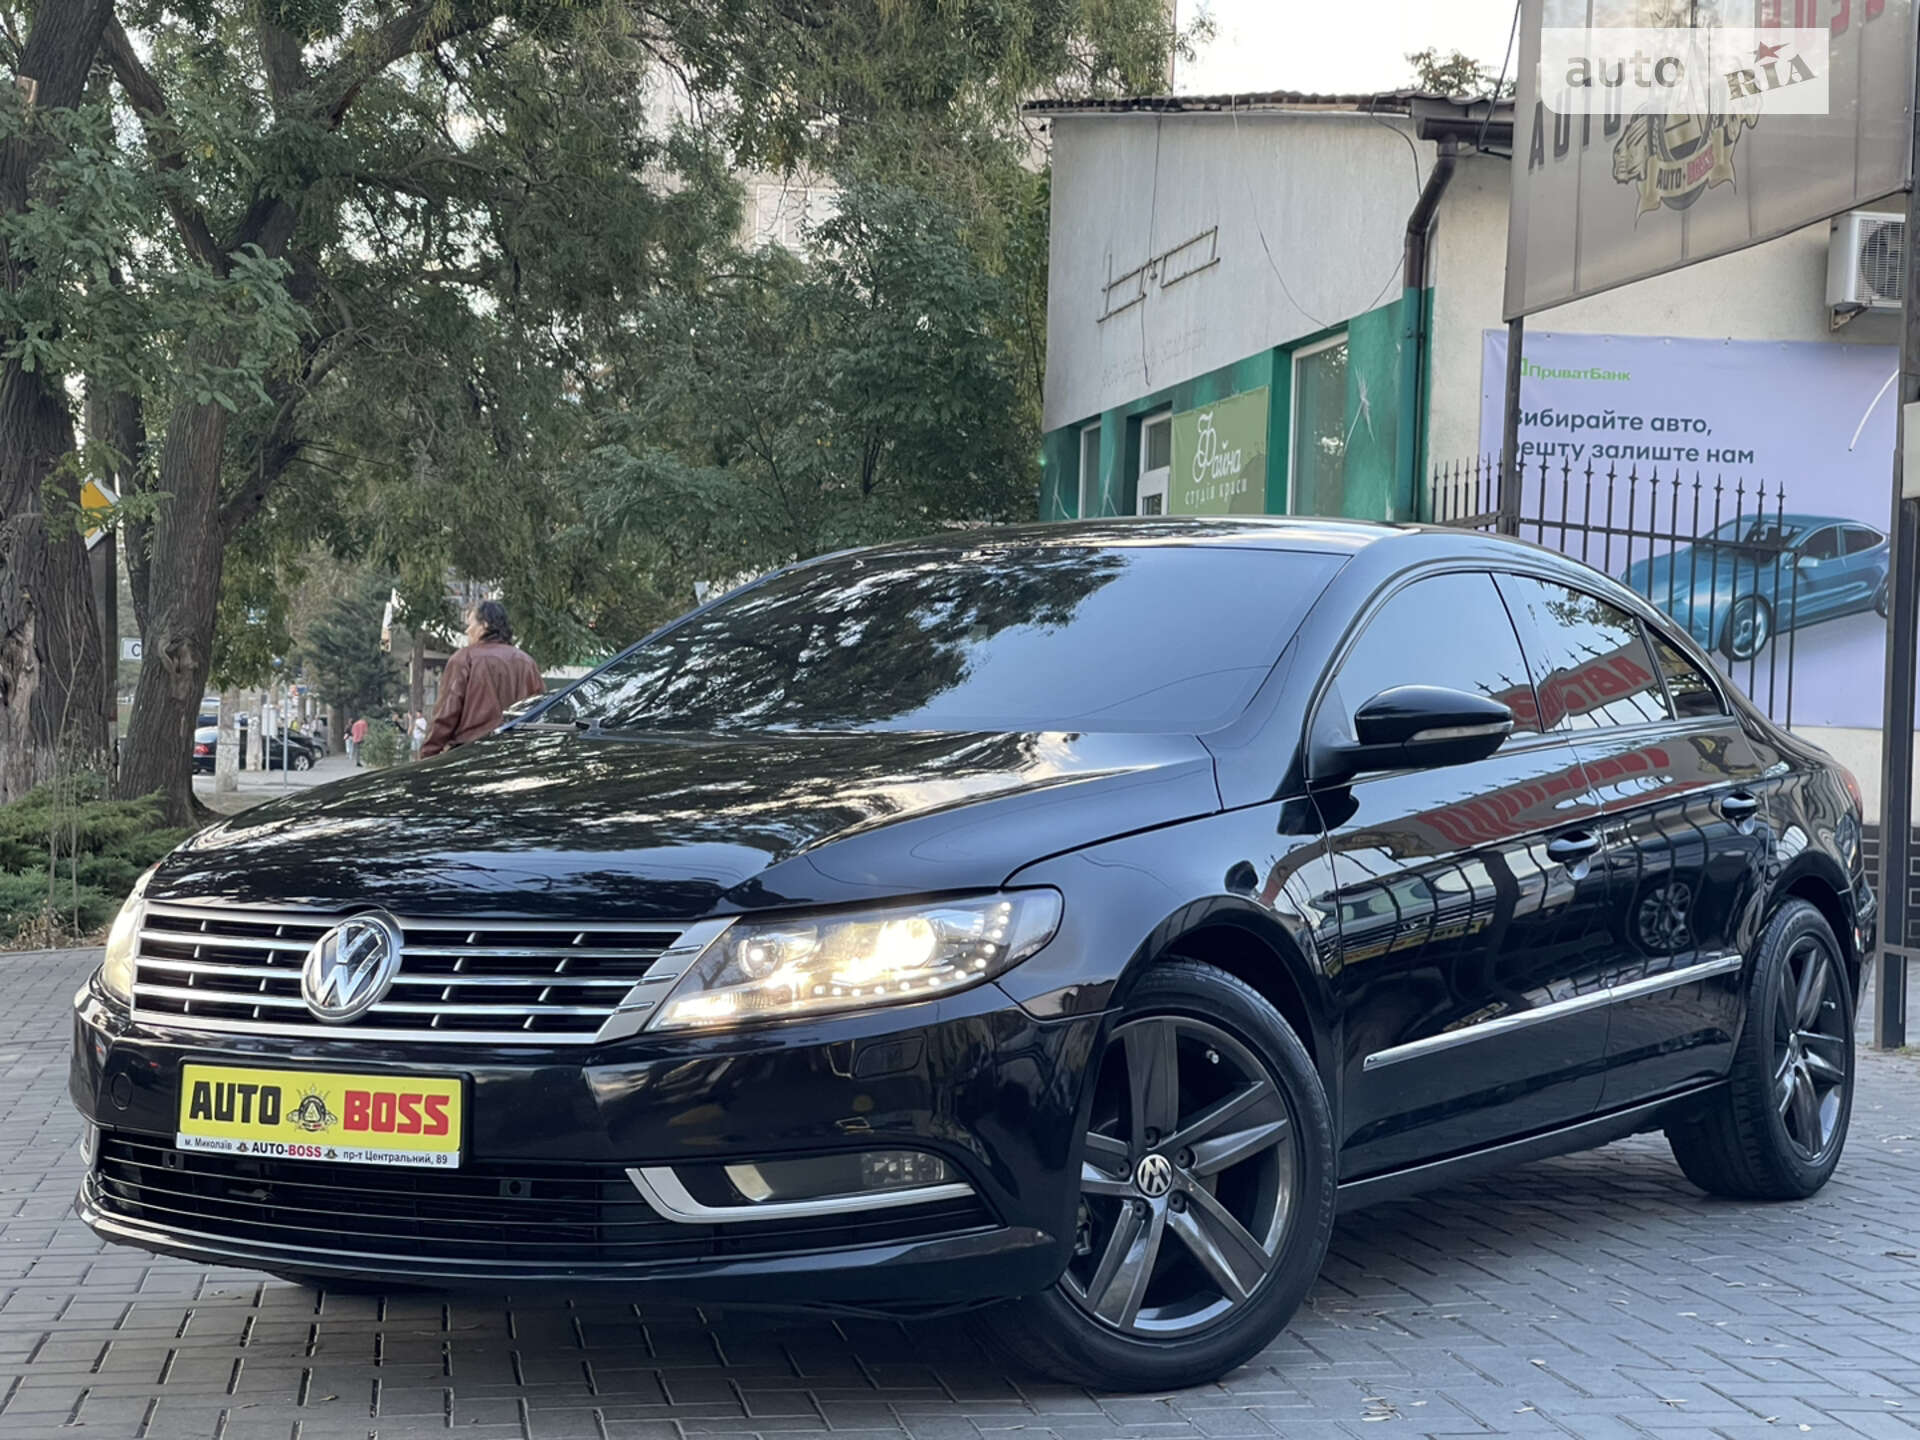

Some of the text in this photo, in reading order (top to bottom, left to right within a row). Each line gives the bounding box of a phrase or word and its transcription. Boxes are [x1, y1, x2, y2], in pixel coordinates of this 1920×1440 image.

[1528, 364, 1631, 381] ПриватБанк
[1651, 416, 1712, 436] авто,
[1516, 441, 1754, 464] ешту залиште нам
[189, 1081, 450, 1136] AUTO BOSS
[252, 1142, 322, 1158] AUTO-BOSS
[343, 1151, 362, 1161] пр-т
[365, 1151, 434, 1165] Центральний,
[436, 1155, 448, 1165] 89
